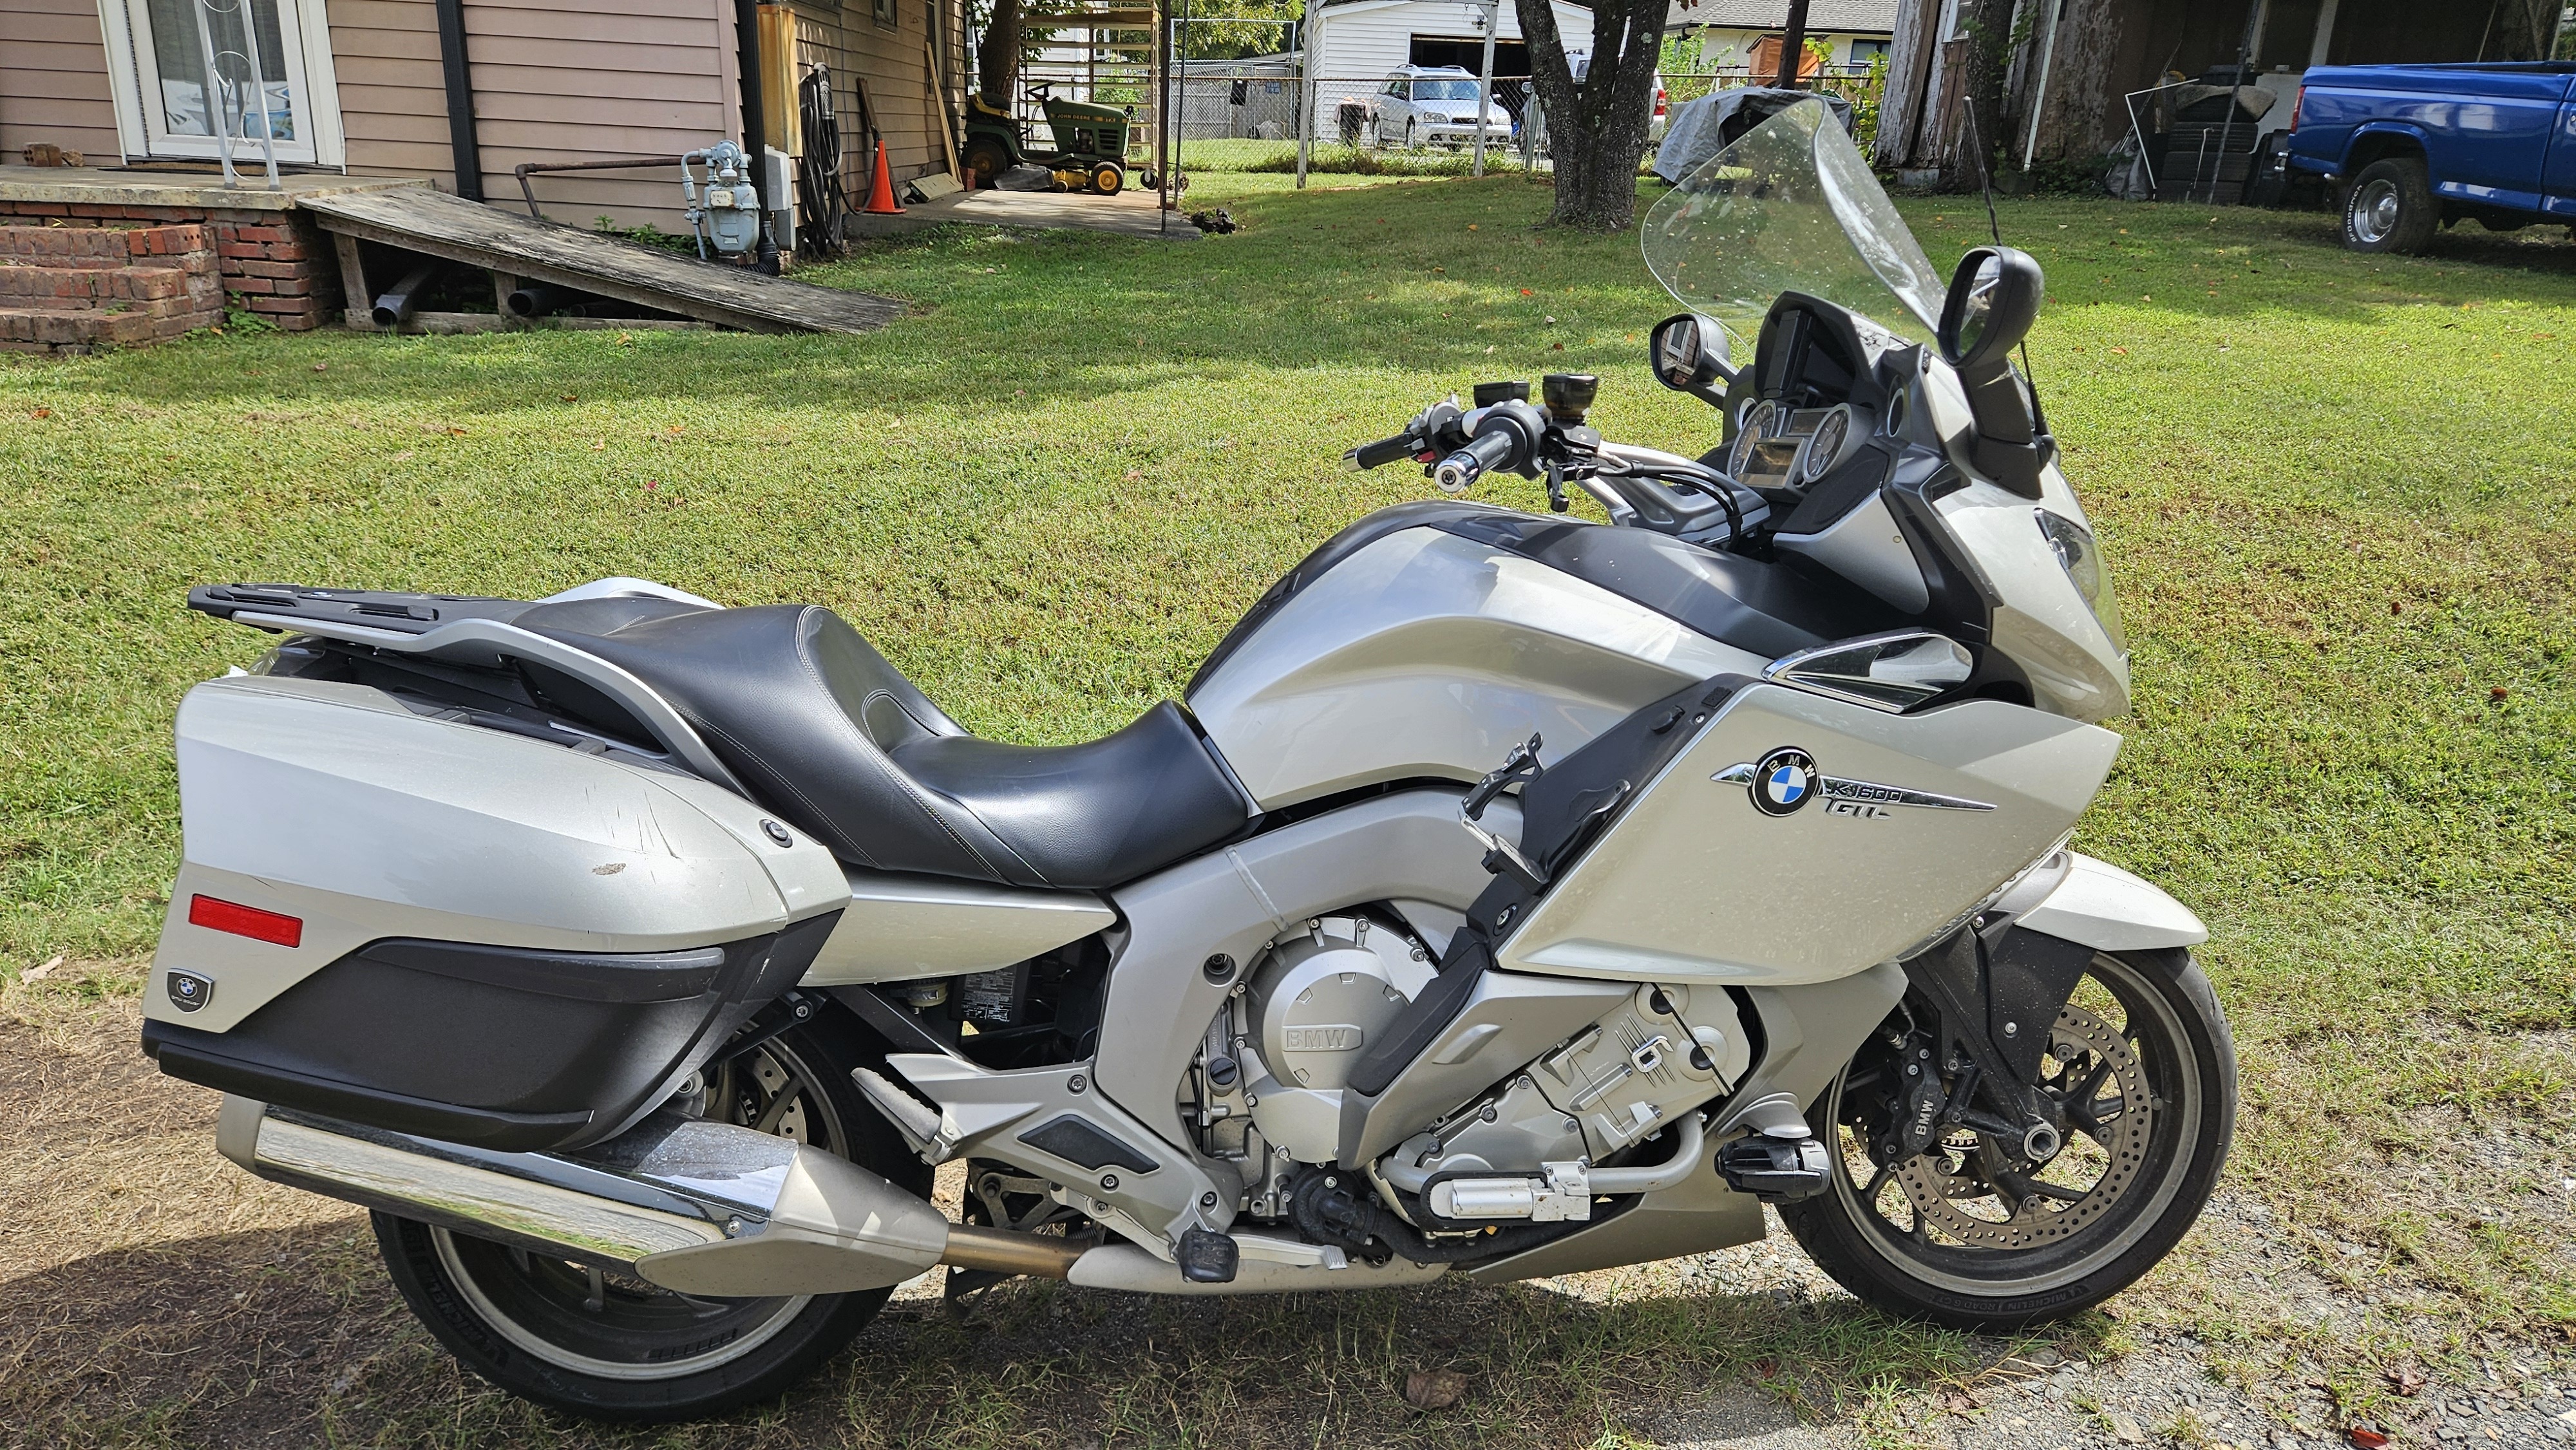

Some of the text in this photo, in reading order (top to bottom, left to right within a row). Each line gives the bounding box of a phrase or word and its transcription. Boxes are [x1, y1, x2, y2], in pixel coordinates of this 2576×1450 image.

[1767, 755, 1815, 778] BMW
[1287, 1030, 1347, 1049] BMW
[1915, 1100, 1934, 1136] BMW
[1964, 1299, 1996, 1310] ROAD
[2007, 1293, 2066, 1310] MICHELIN
